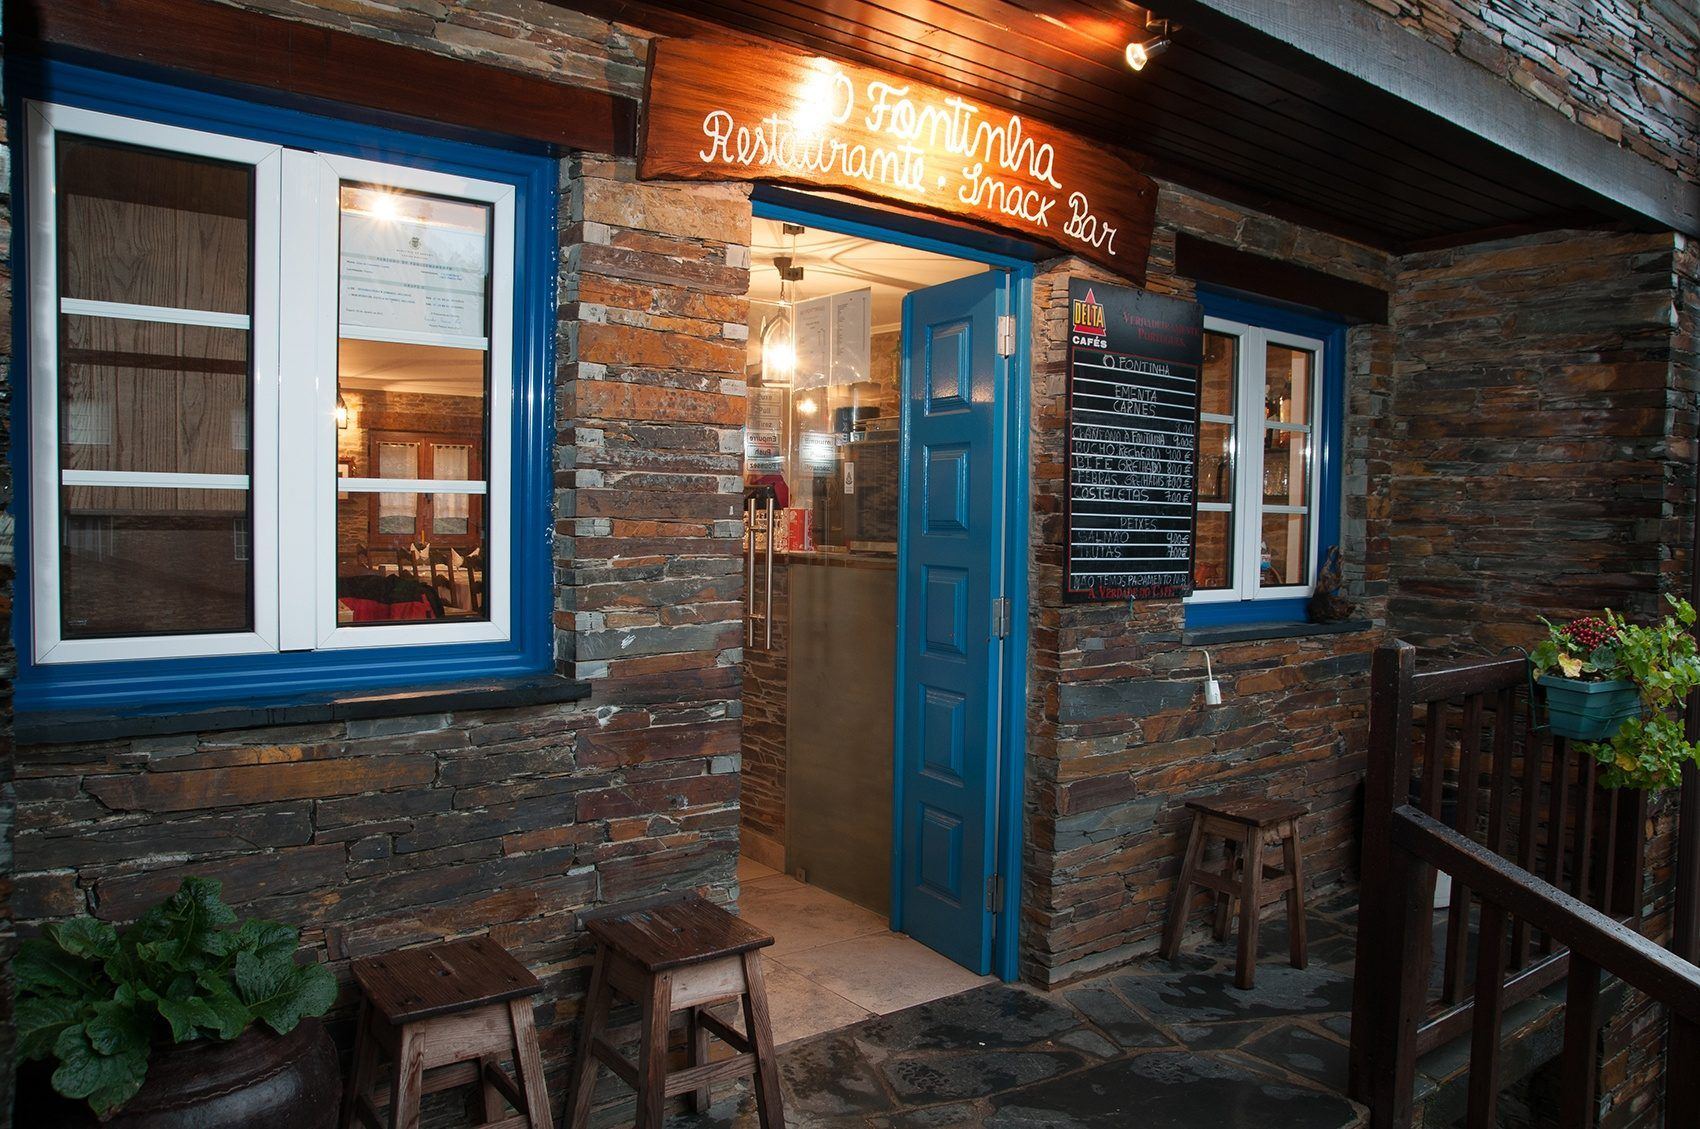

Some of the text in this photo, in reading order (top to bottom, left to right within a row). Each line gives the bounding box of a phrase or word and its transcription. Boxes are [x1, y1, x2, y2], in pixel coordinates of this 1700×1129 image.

[866, 81, 1062, 188] Fontinha
[700, 110, 1118, 255] Restaurante Snack Bar
[1074, 301, 1104, 327] DELTA
[1072, 335, 1107, 349] CAFÉS
[1102, 354, 1170, 375] O FONTINHA
[1115, 384, 1157, 402] EMENTA
[1113, 400, 1157, 416] CARNES
[1075, 441, 1115, 457] BUCHO
[1075, 456, 1113, 470] BIFE
[1184, 465, 1191, 476] €
[1077, 470, 1118, 486] FEBRAS
[1183, 478, 1191, 489] €
[1074, 486, 1149, 502] COSTELETAS
[1183, 492, 1191, 503] €
[1120, 516, 1157, 531] PEIXES
[1077, 545, 1122, 558] TRUTAS
[1097, 574, 1126, 588] TEMOS
